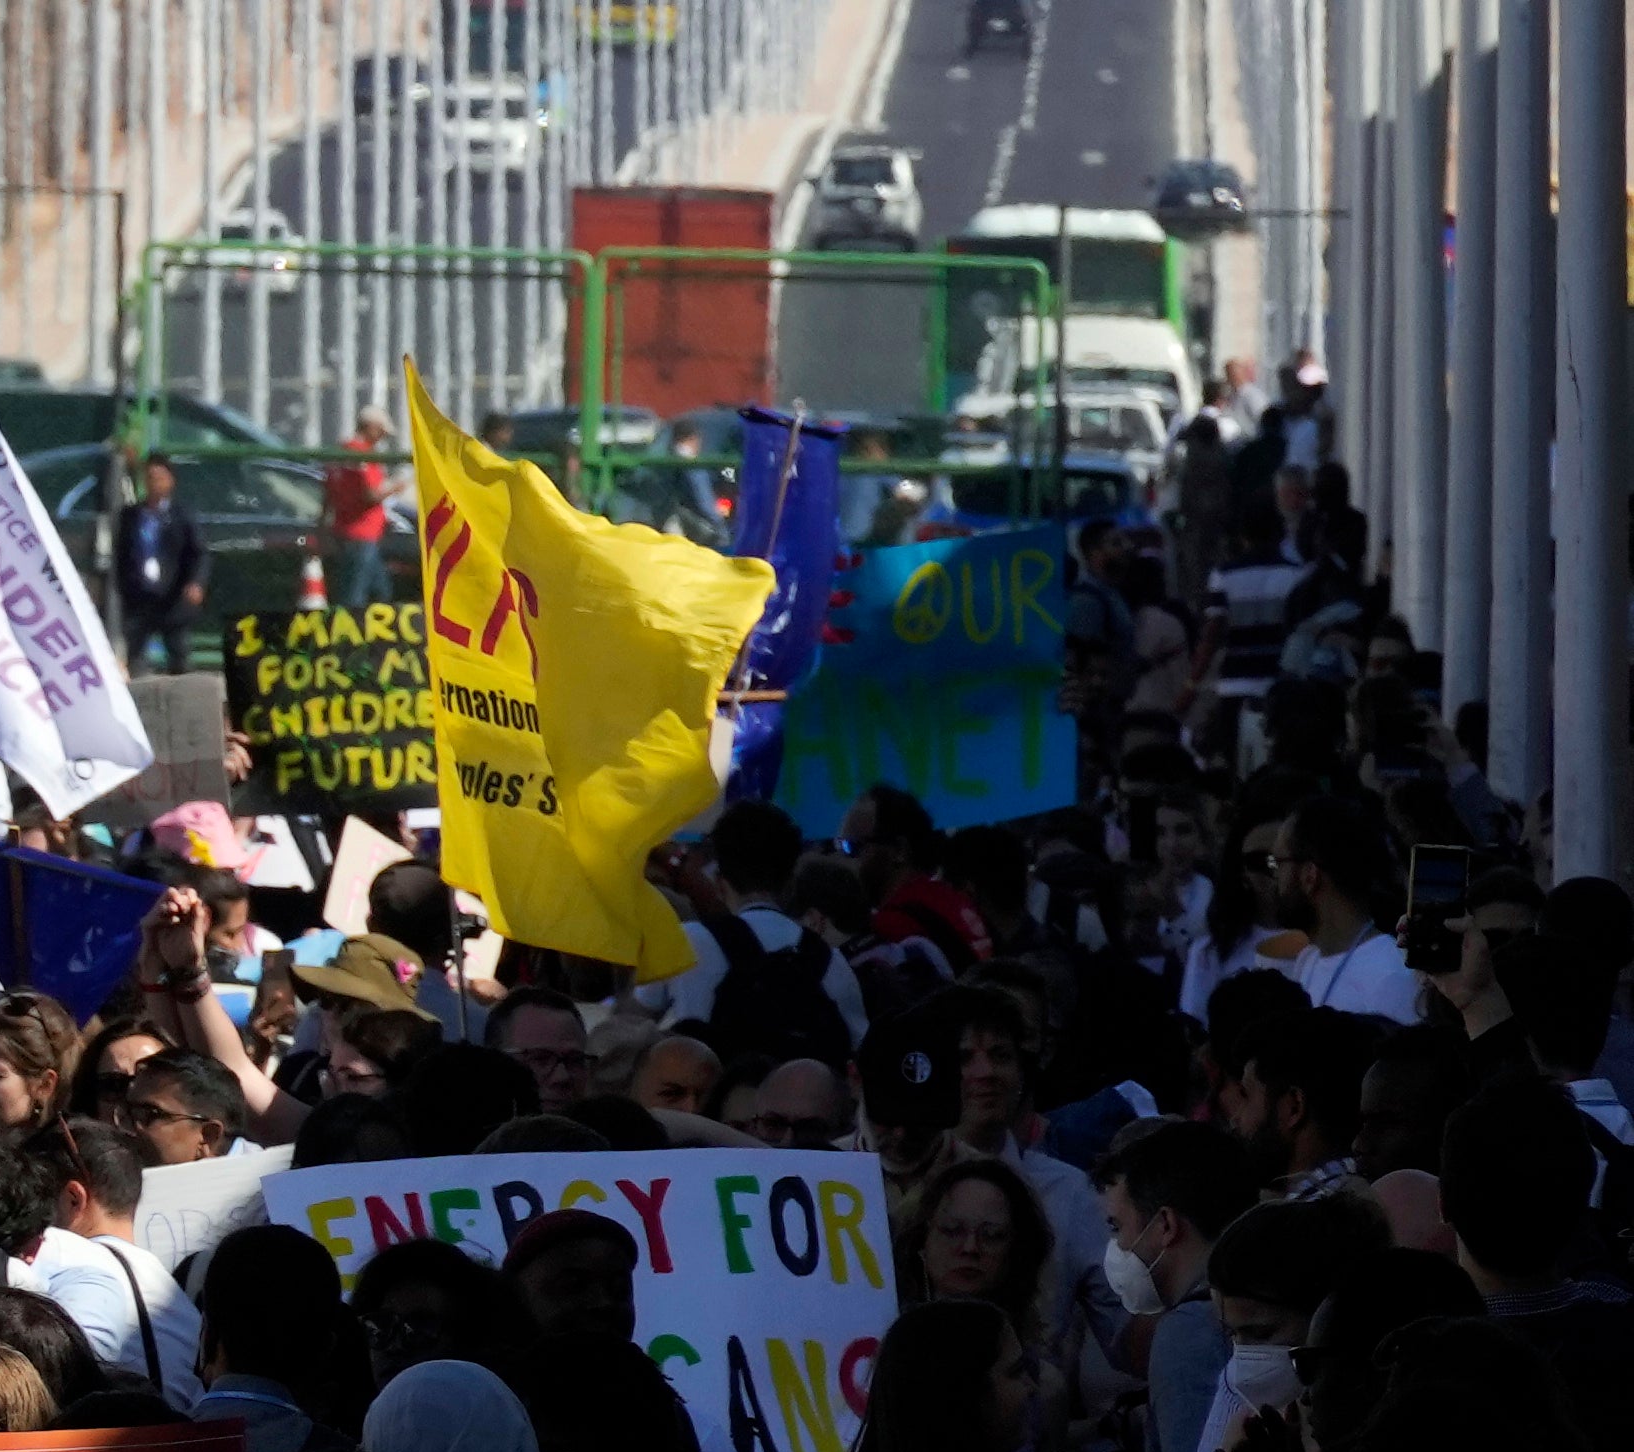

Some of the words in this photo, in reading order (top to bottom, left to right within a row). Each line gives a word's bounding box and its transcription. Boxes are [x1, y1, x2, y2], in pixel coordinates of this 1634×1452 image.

[235, 614, 264, 657] I
[286, 602, 425, 648] MARC
[257, 654, 352, 696] FOR
[377, 647, 426, 686] M
[439, 677, 542, 735] ernation
[715, 1174, 885, 1291] FOR
